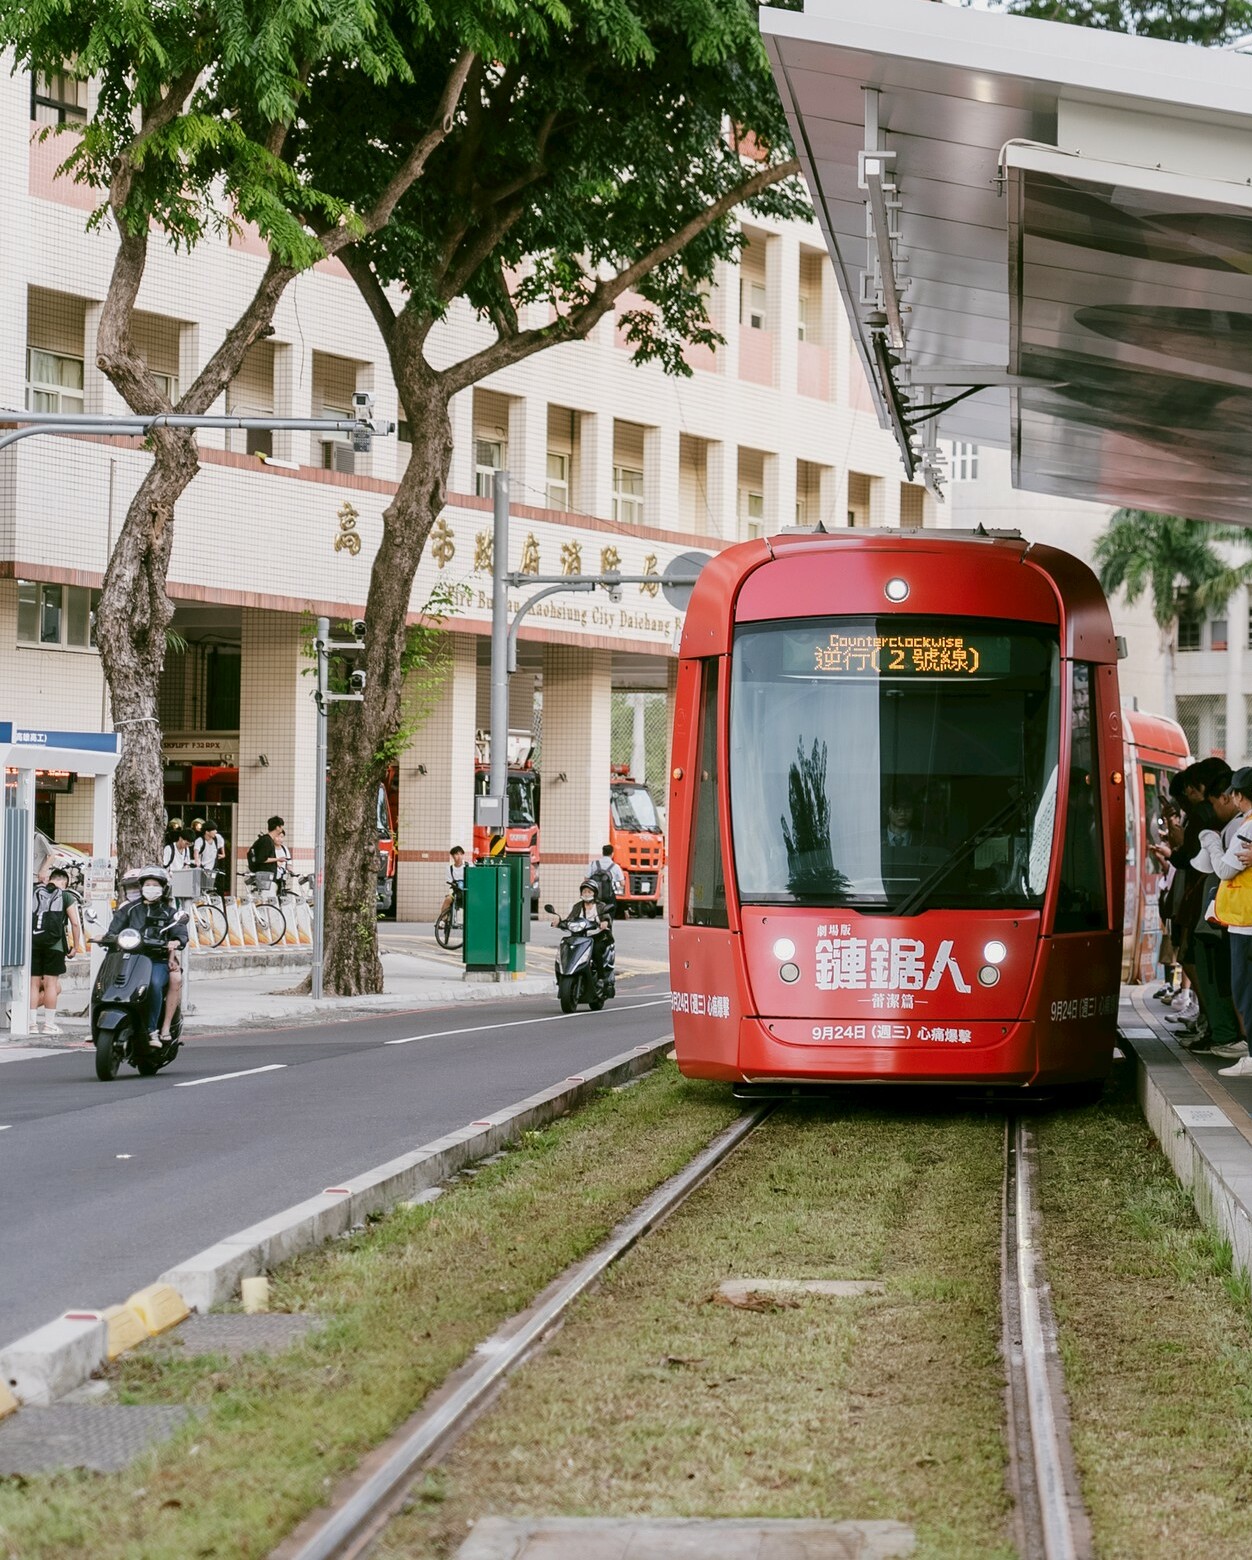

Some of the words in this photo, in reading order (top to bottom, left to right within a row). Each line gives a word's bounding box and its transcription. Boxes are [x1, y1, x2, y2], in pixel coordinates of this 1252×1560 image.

[592, 606, 615, 629] City
[829, 634, 964, 648] Counterclockwise
[816, 924, 852, 937] 劇場版
[815, 937, 972, 994] 鏈鋸人
